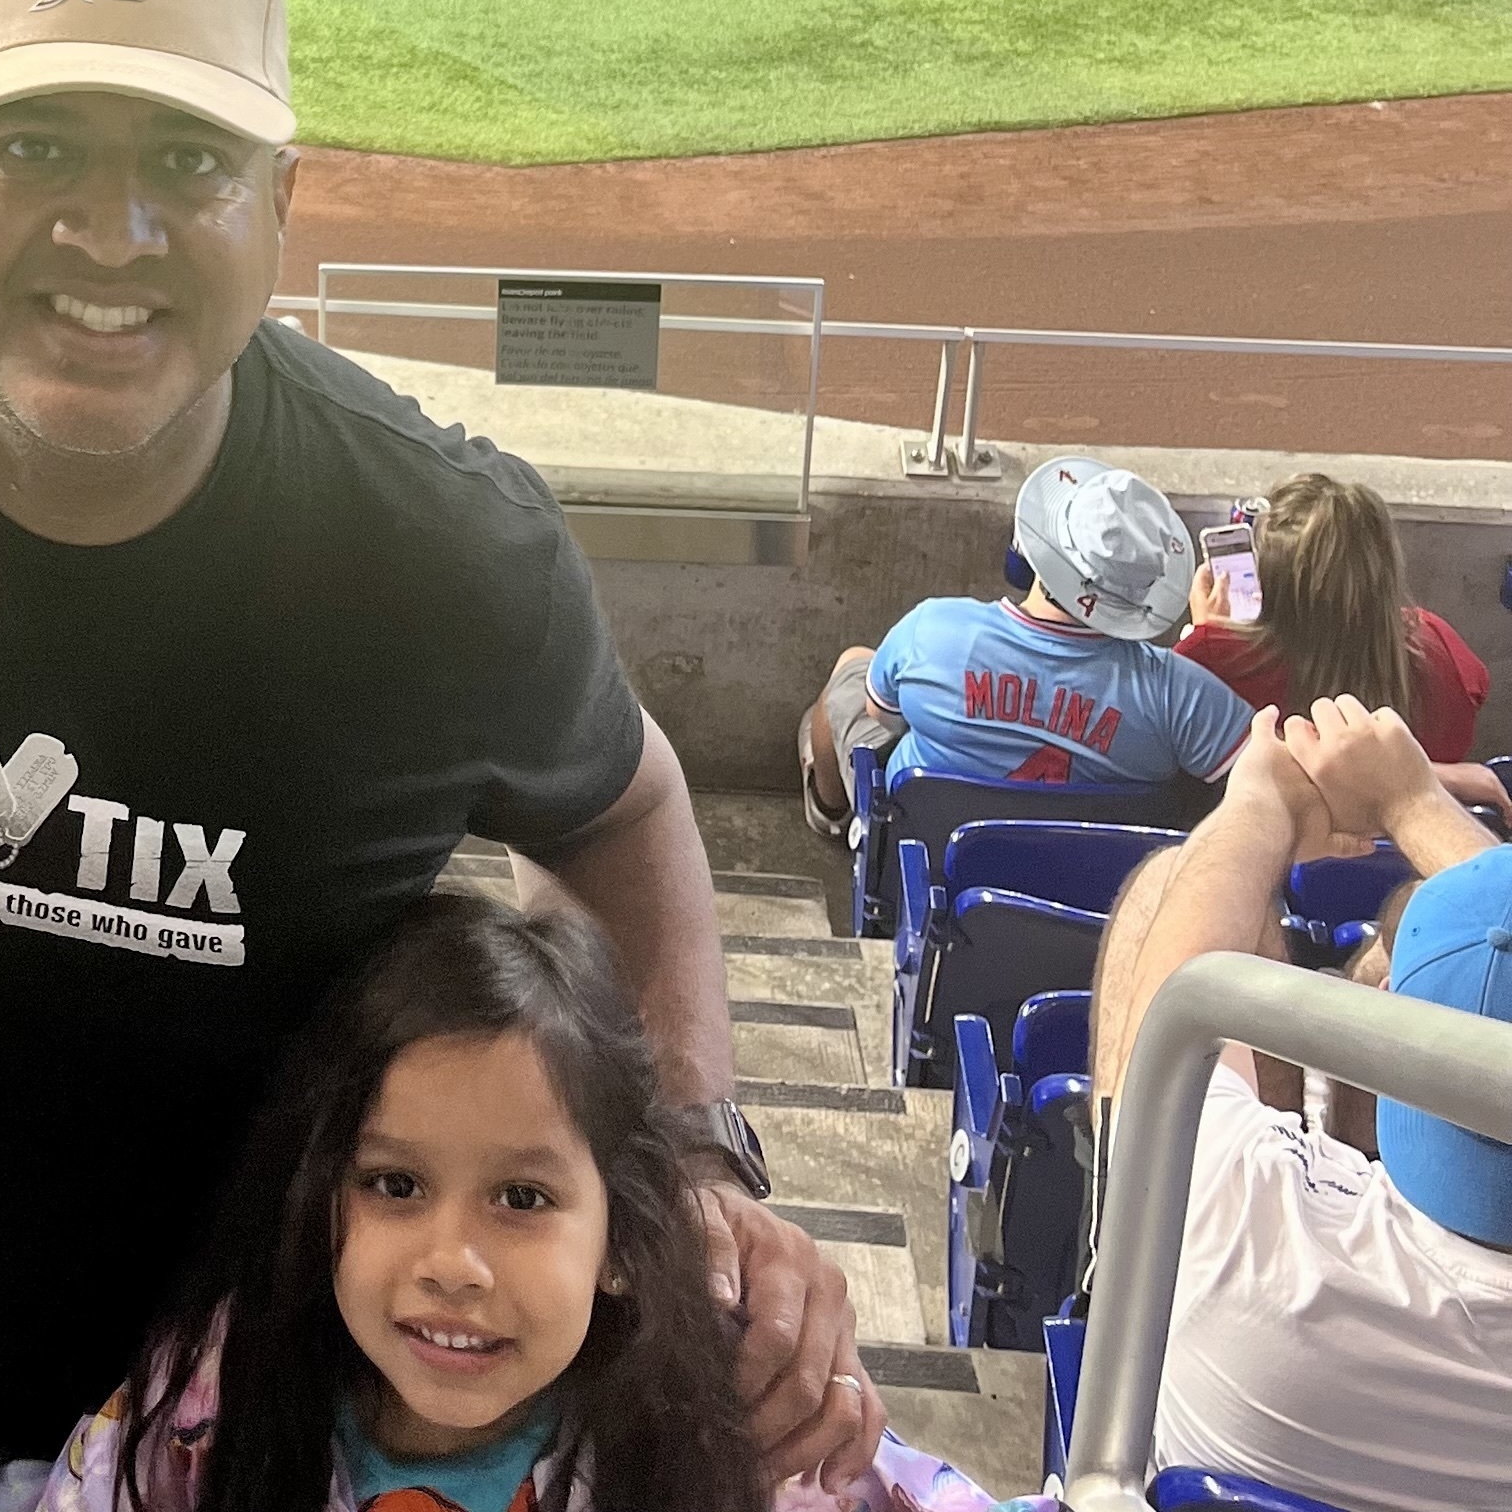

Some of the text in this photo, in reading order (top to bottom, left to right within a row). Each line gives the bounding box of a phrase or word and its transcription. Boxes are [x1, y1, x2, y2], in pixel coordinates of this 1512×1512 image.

[1076, 592, 1099, 618] 4
[964, 670, 1123, 755] MOLINA
[67, 794, 247, 914] TIX
[6, 893, 82, 927] those
[91, 913, 148, 942] who
[158, 928, 223, 954] gave
